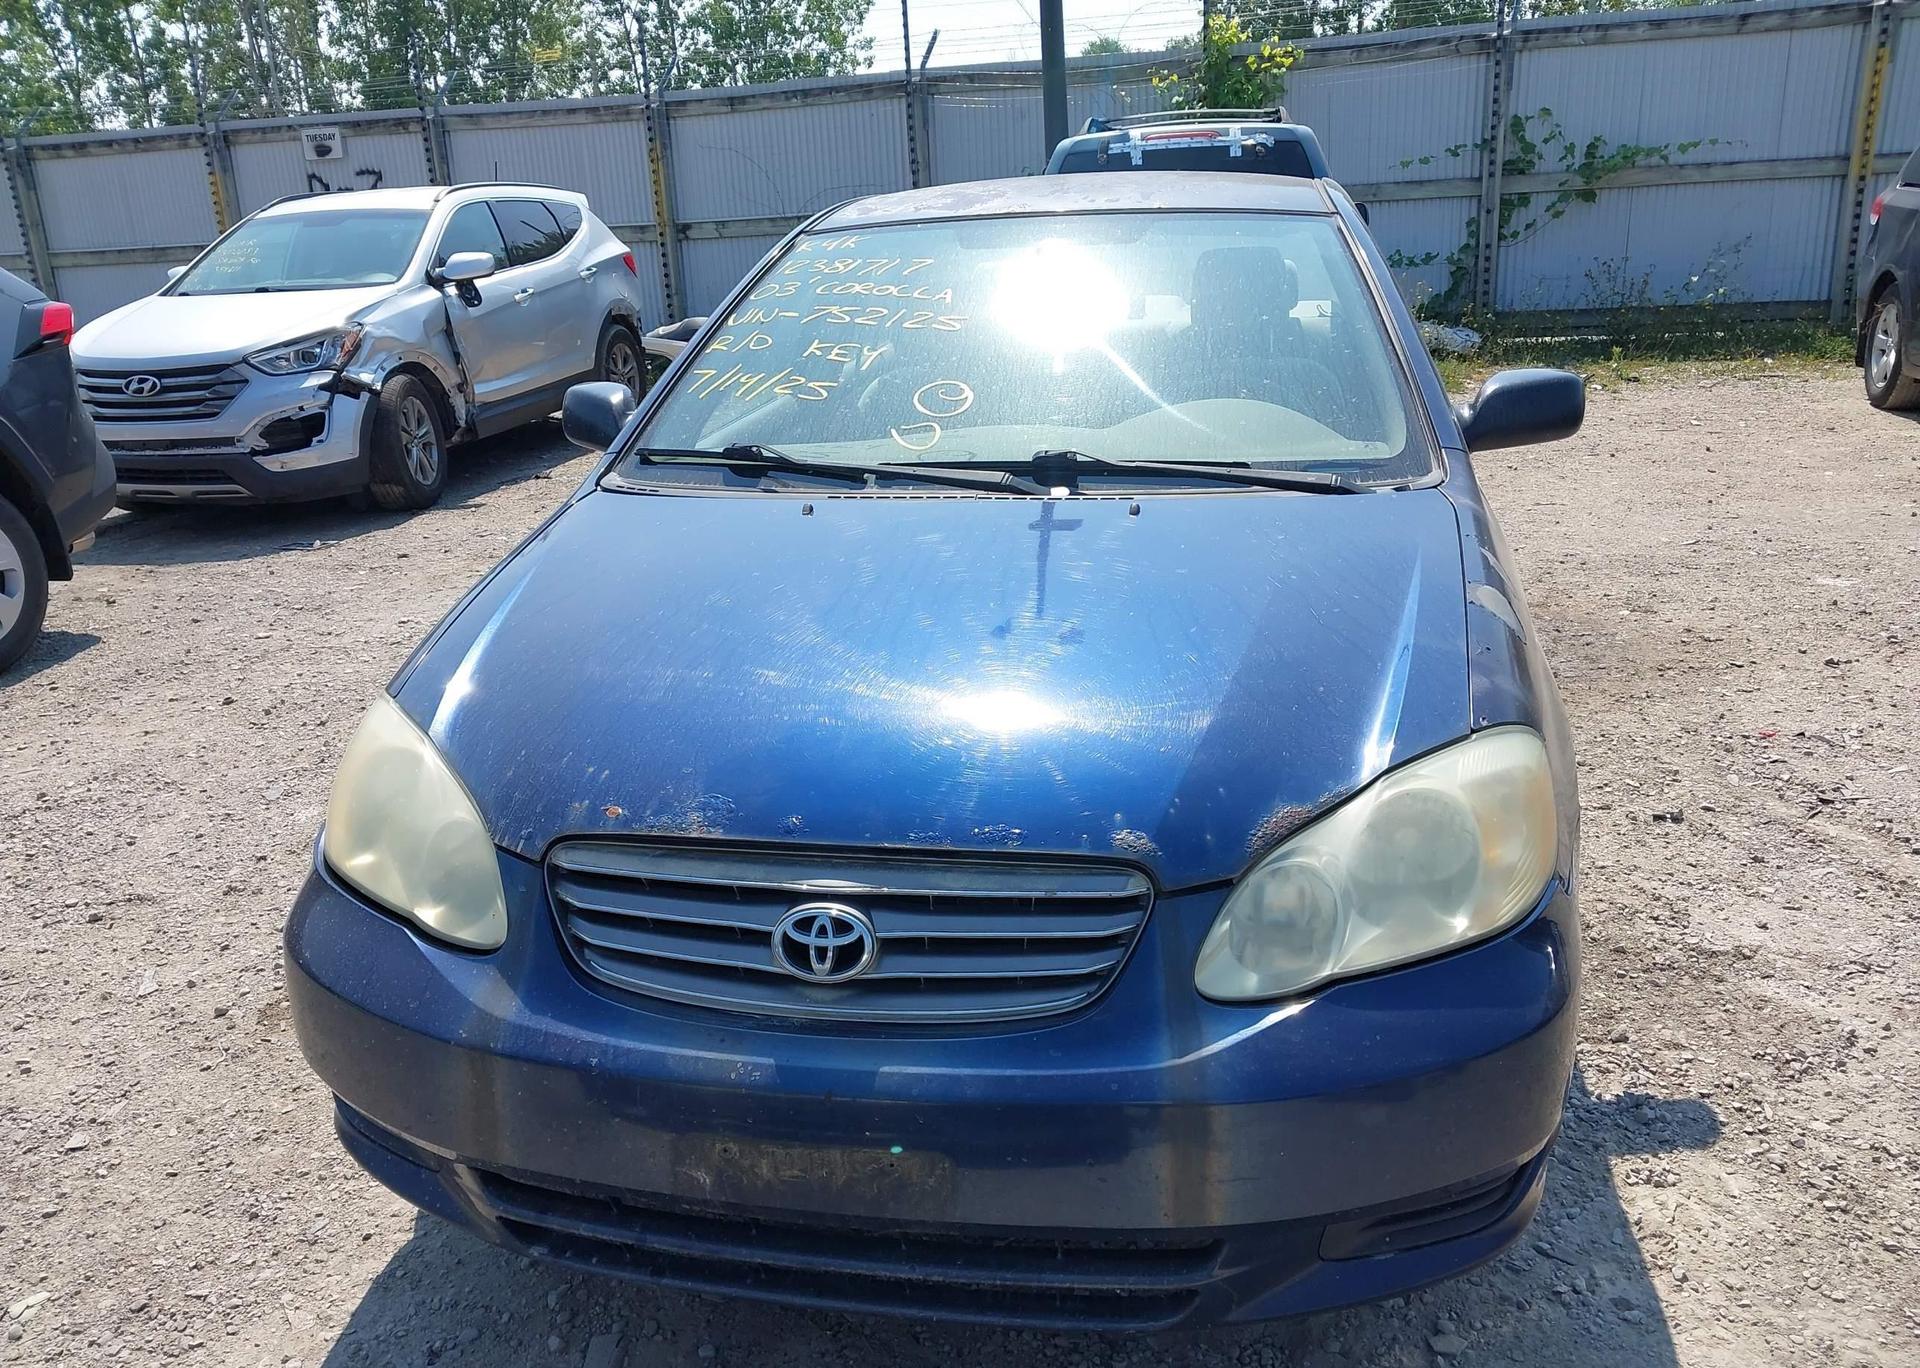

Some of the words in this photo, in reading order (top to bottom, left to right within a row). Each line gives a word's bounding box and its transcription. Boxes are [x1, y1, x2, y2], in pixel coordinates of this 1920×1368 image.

[305, 133, 336, 142] TUESDAY
[815, 282, 952, 304] COROLLA
[803, 338, 890, 371] KEY
[687, 363, 838, 402] 7/14/25
